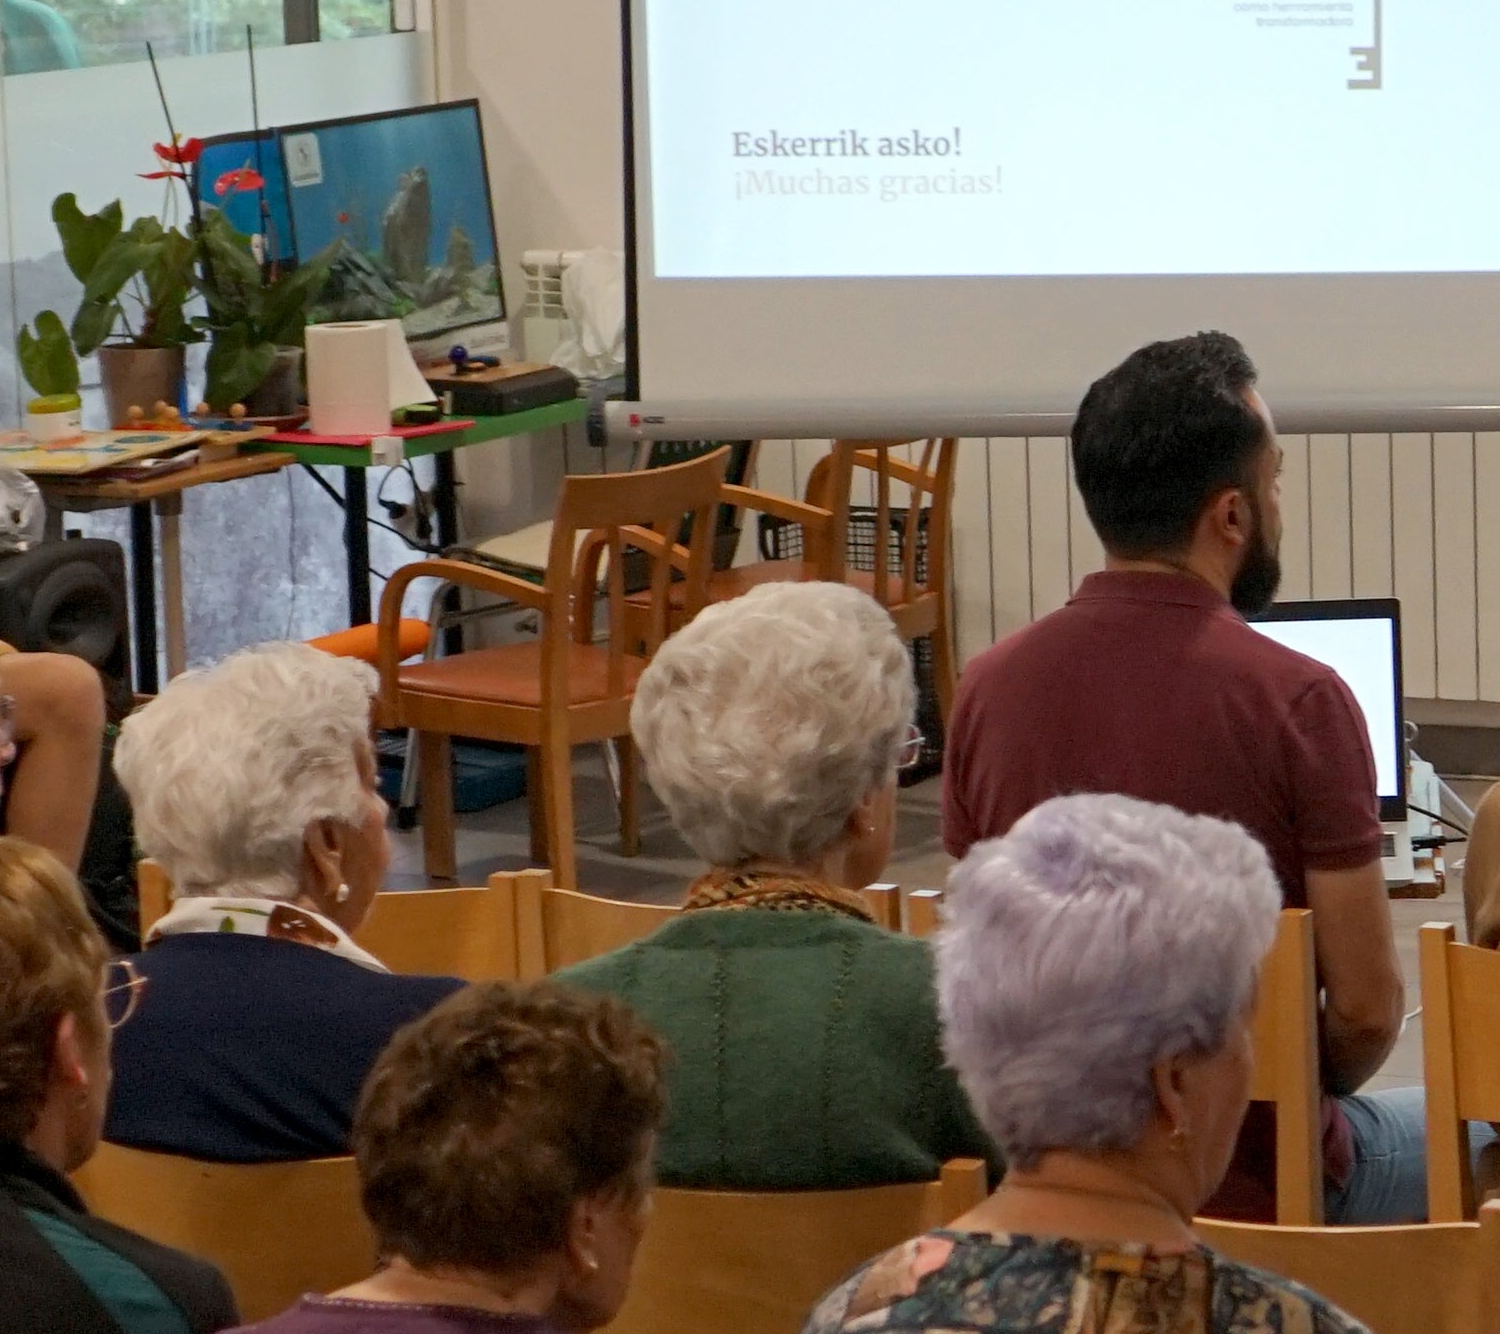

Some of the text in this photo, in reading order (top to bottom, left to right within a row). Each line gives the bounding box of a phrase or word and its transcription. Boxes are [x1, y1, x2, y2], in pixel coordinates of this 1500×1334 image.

[731, 126, 962, 158] Eskerrik asko!
[734, 165, 1003, 203] ¡Muchas gracias!
